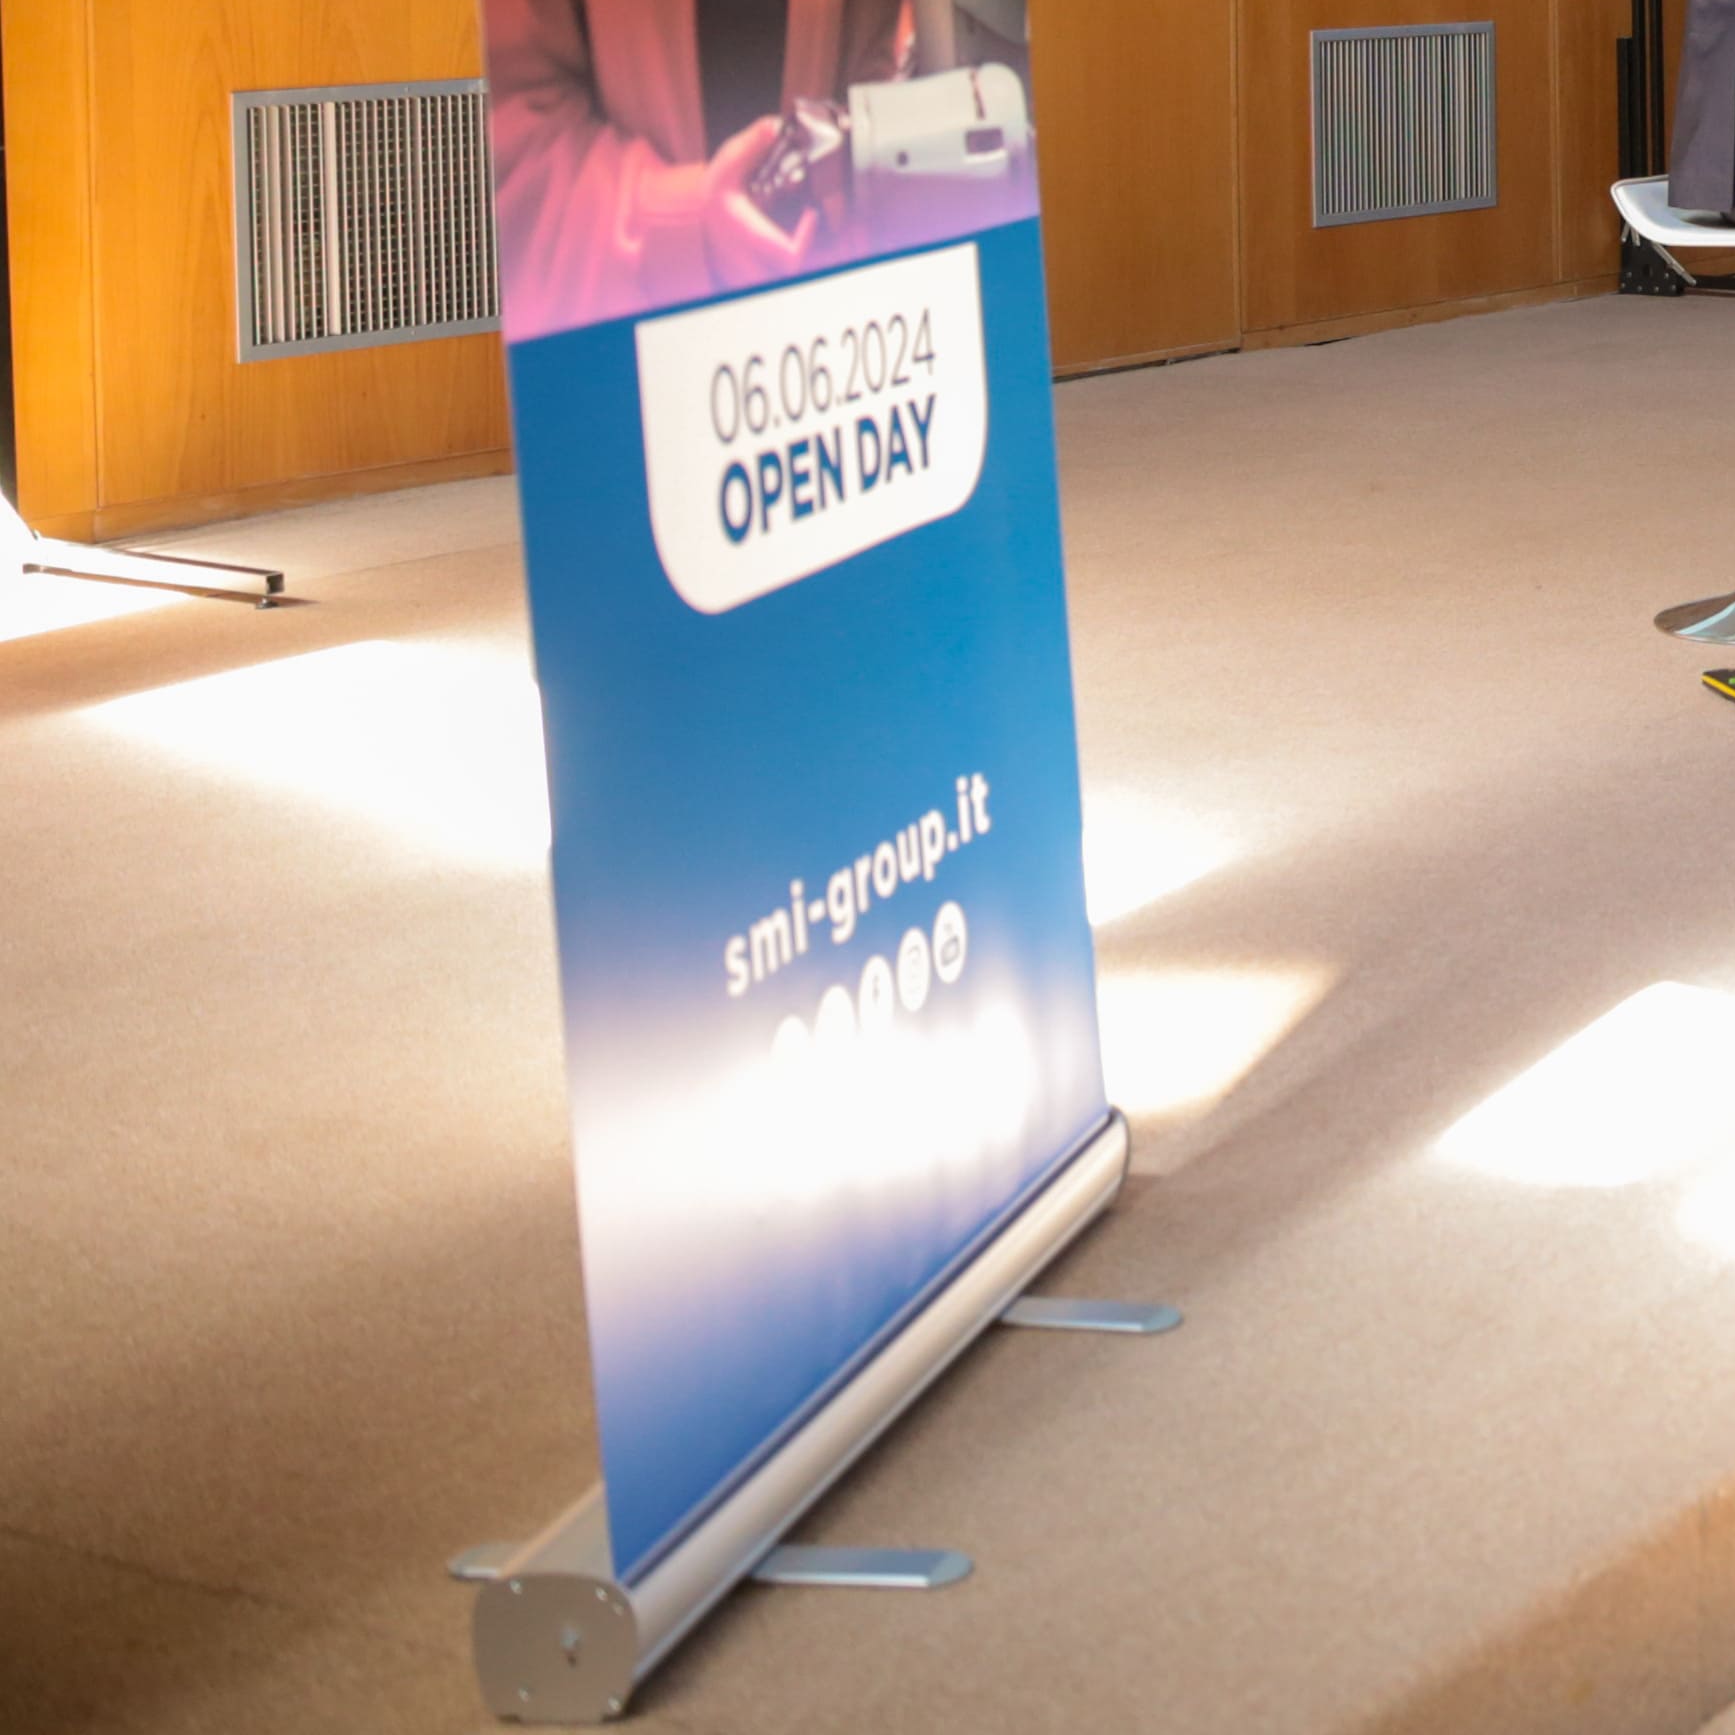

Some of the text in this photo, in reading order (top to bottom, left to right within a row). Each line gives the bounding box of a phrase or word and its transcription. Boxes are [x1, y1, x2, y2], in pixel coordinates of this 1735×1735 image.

[709, 307, 936, 445] 06.06.2024
[719, 392, 936, 546] OPEN DAY
[724, 771, 991, 997] smi-group.it
